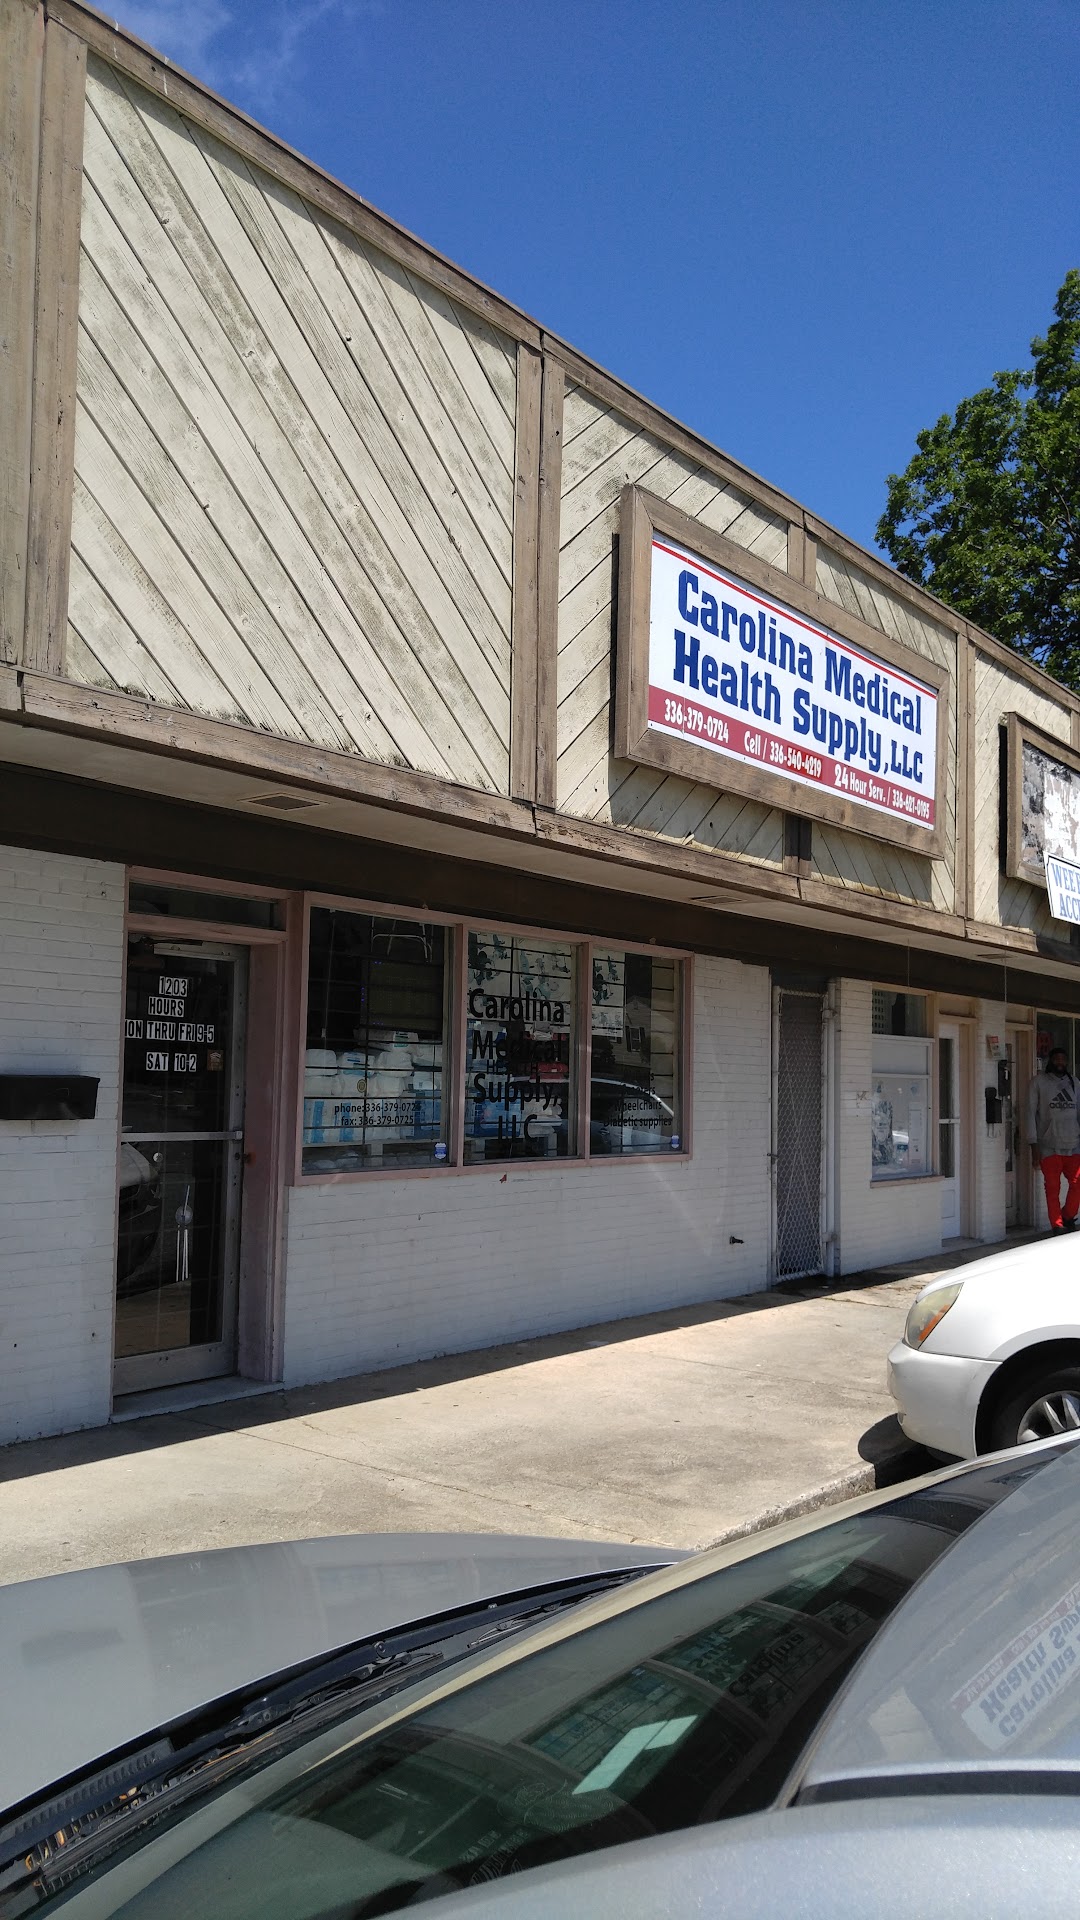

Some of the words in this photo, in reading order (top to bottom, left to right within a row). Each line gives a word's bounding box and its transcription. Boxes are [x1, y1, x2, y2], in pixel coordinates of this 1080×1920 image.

[678, 569, 814, 684] Carolina
[824, 646, 921, 735] Medical
[673, 628, 781, 725] Health
[664, 699, 729, 744] 336-379-0724
[744, 730, 761, 756] Cell
[769, 741, 822, 778] 336-540-4219
[834, 763, 849, 790] 24
[850, 772, 867, 795] Hour
[160, 977, 187, 996] 1203
[149, 997, 184, 1017] HOURS
[469, 988, 564, 1022] Carolina
[125, 1020, 142, 1038] ON
[147, 1021, 175, 1040] THRU
[179, 1023, 195, 1041] FRI
[147, 1052, 168, 1071] SAT
[175, 1053, 196, 1072] 10-2
[474, 1073, 558, 1111] Supply,
[341, 1116, 357, 1126] fax:
[359, 1115, 414, 1126] 336-379-0725
